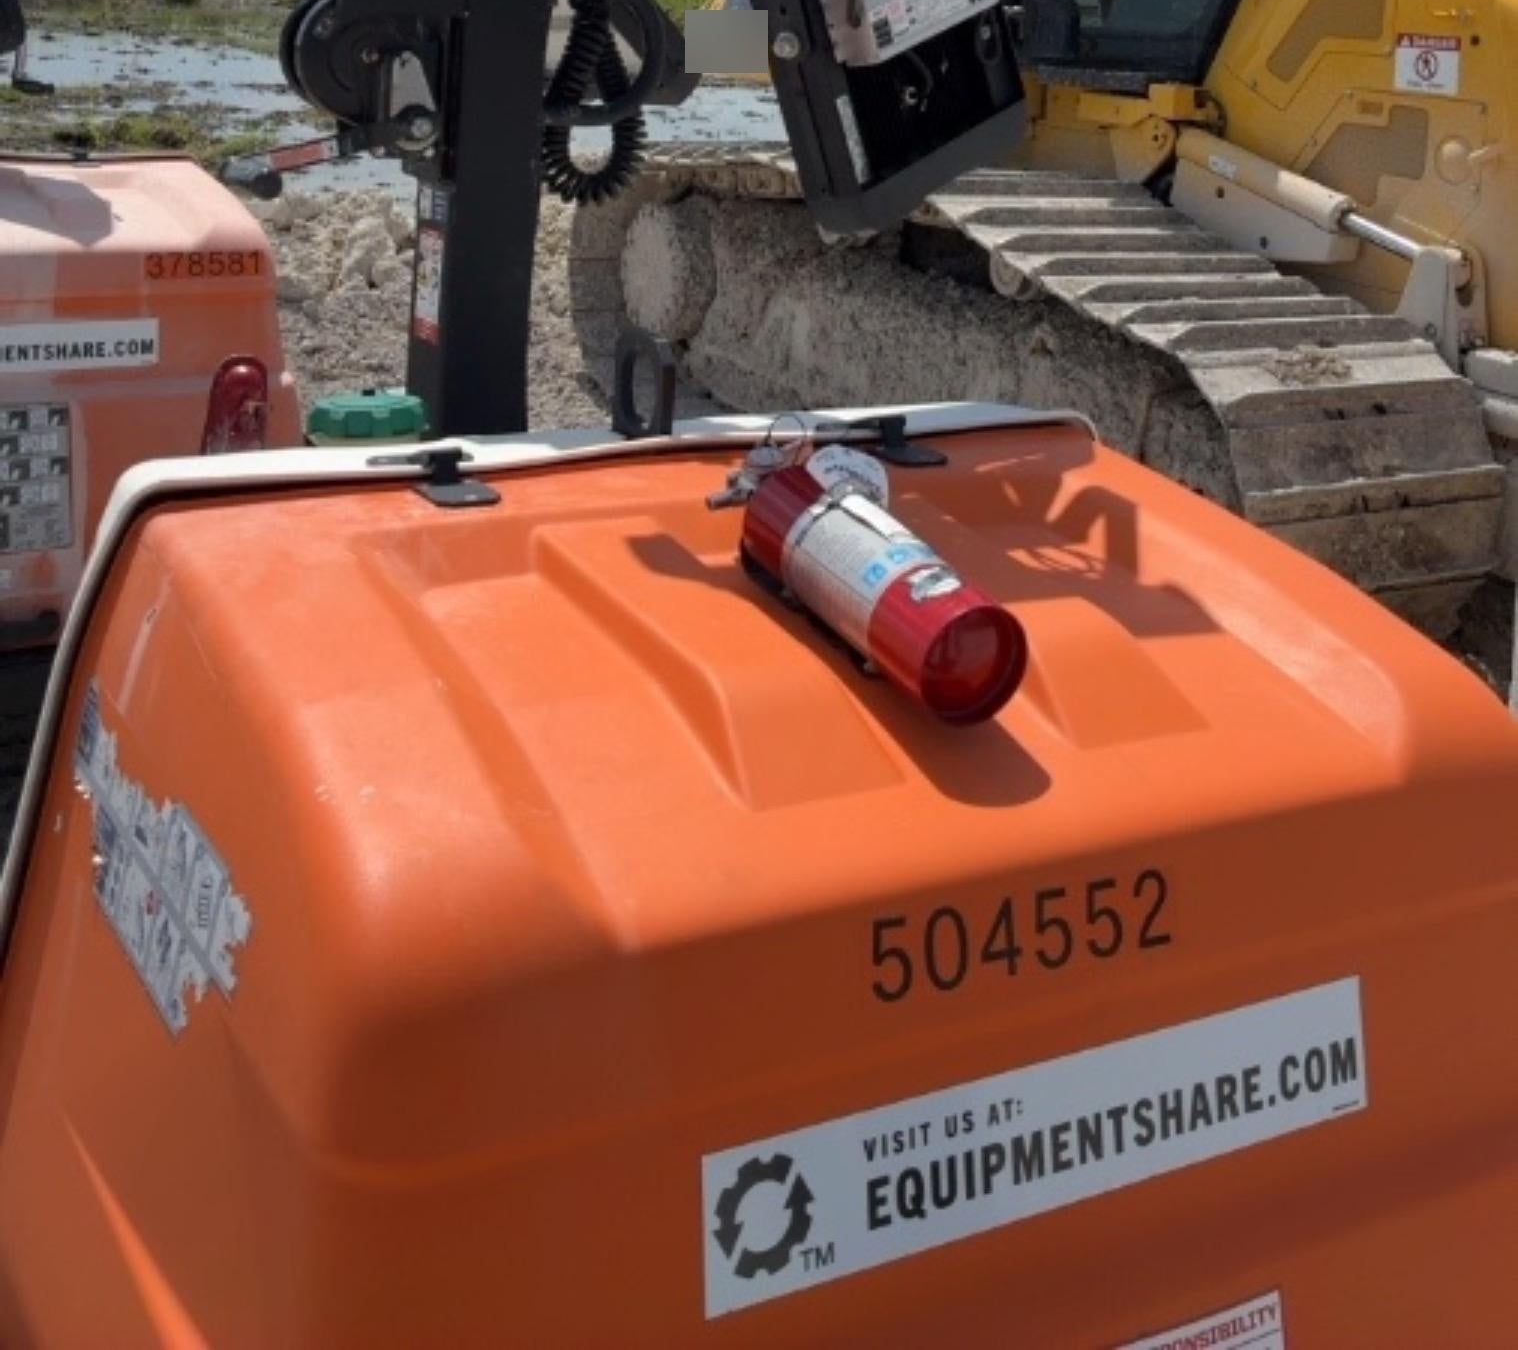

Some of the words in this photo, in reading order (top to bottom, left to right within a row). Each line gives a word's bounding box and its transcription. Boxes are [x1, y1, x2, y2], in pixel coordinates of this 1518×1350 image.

[145, 251, 261, 280] 378581
[0, 338, 155, 362] ENTSHARE.COM
[871, 868, 1172, 1003] 504552
[863, 1122, 931, 1162] VISIT
[944, 1110, 974, 1138] US
[987, 1098, 1023, 1126] AT:
[866, 1037, 1358, 1230] EQUIPMENTSHARE.COM
[800, 1241, 835, 1272] TM
[1152, 1303, 1277, 1350] ONSIBILITY
